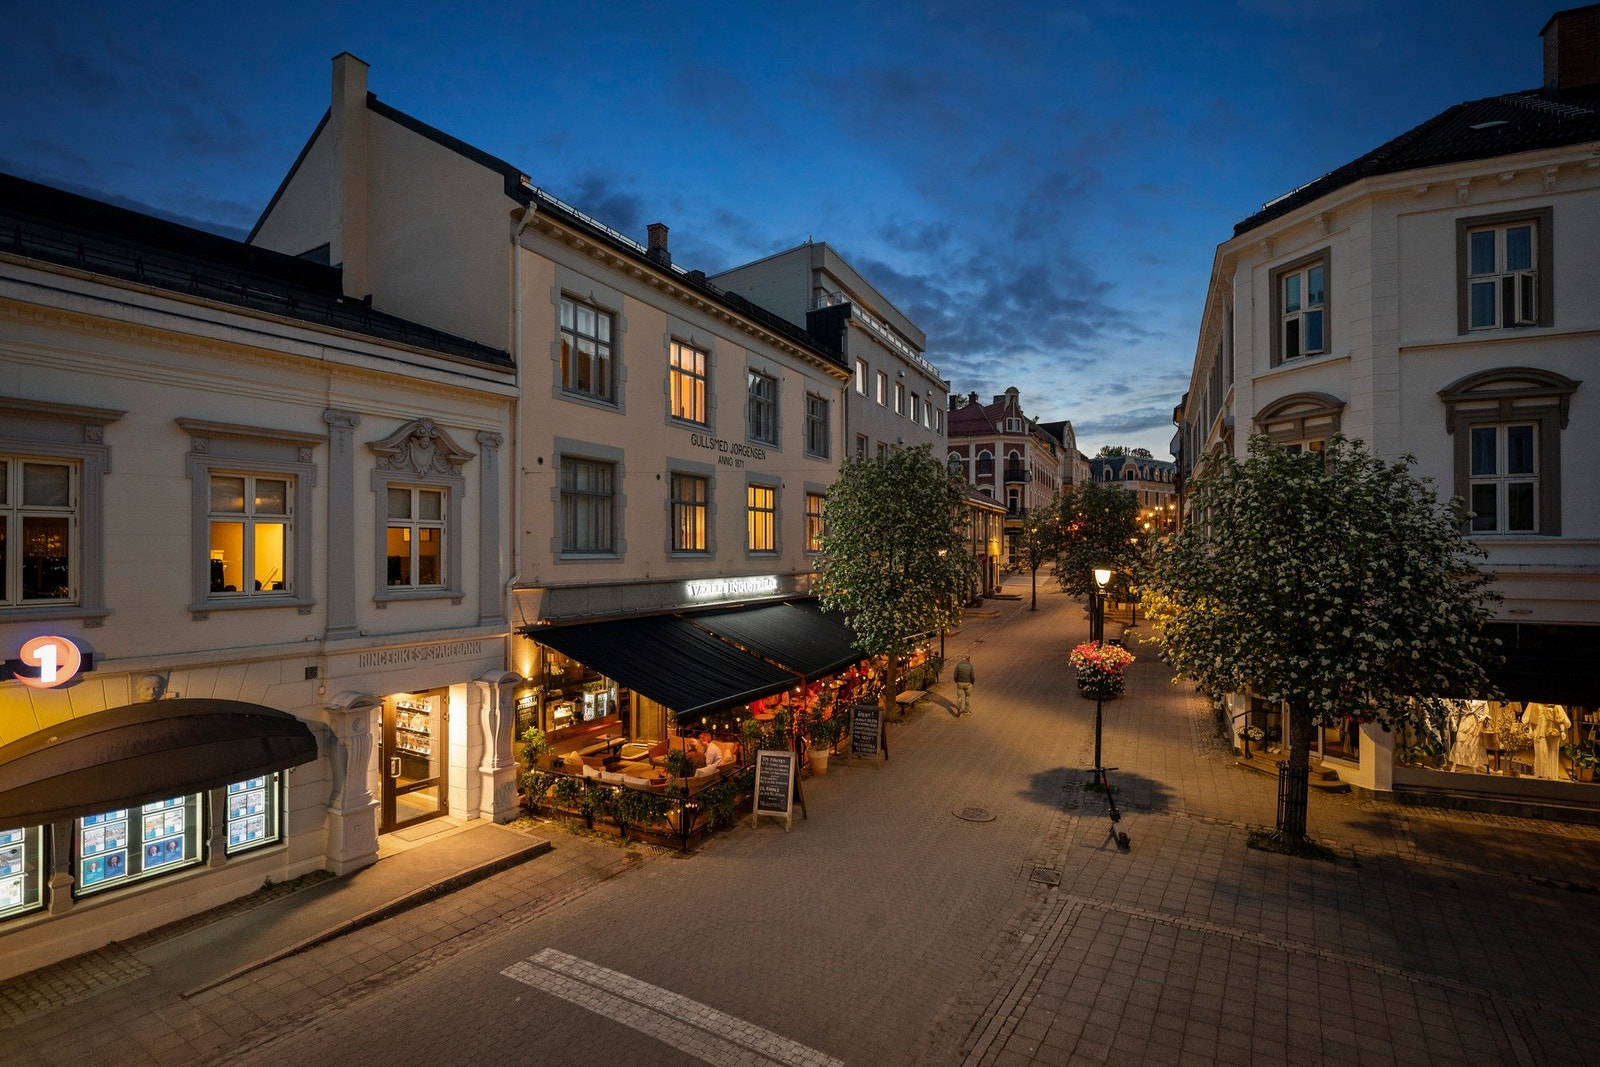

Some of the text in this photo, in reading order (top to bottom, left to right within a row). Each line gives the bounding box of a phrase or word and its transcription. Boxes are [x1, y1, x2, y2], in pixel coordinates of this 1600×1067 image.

[691, 433, 728, 452] GULLSMED
[718, 456, 733, 467] ANNO
[428, 641, 482, 660] SPAREBANK
